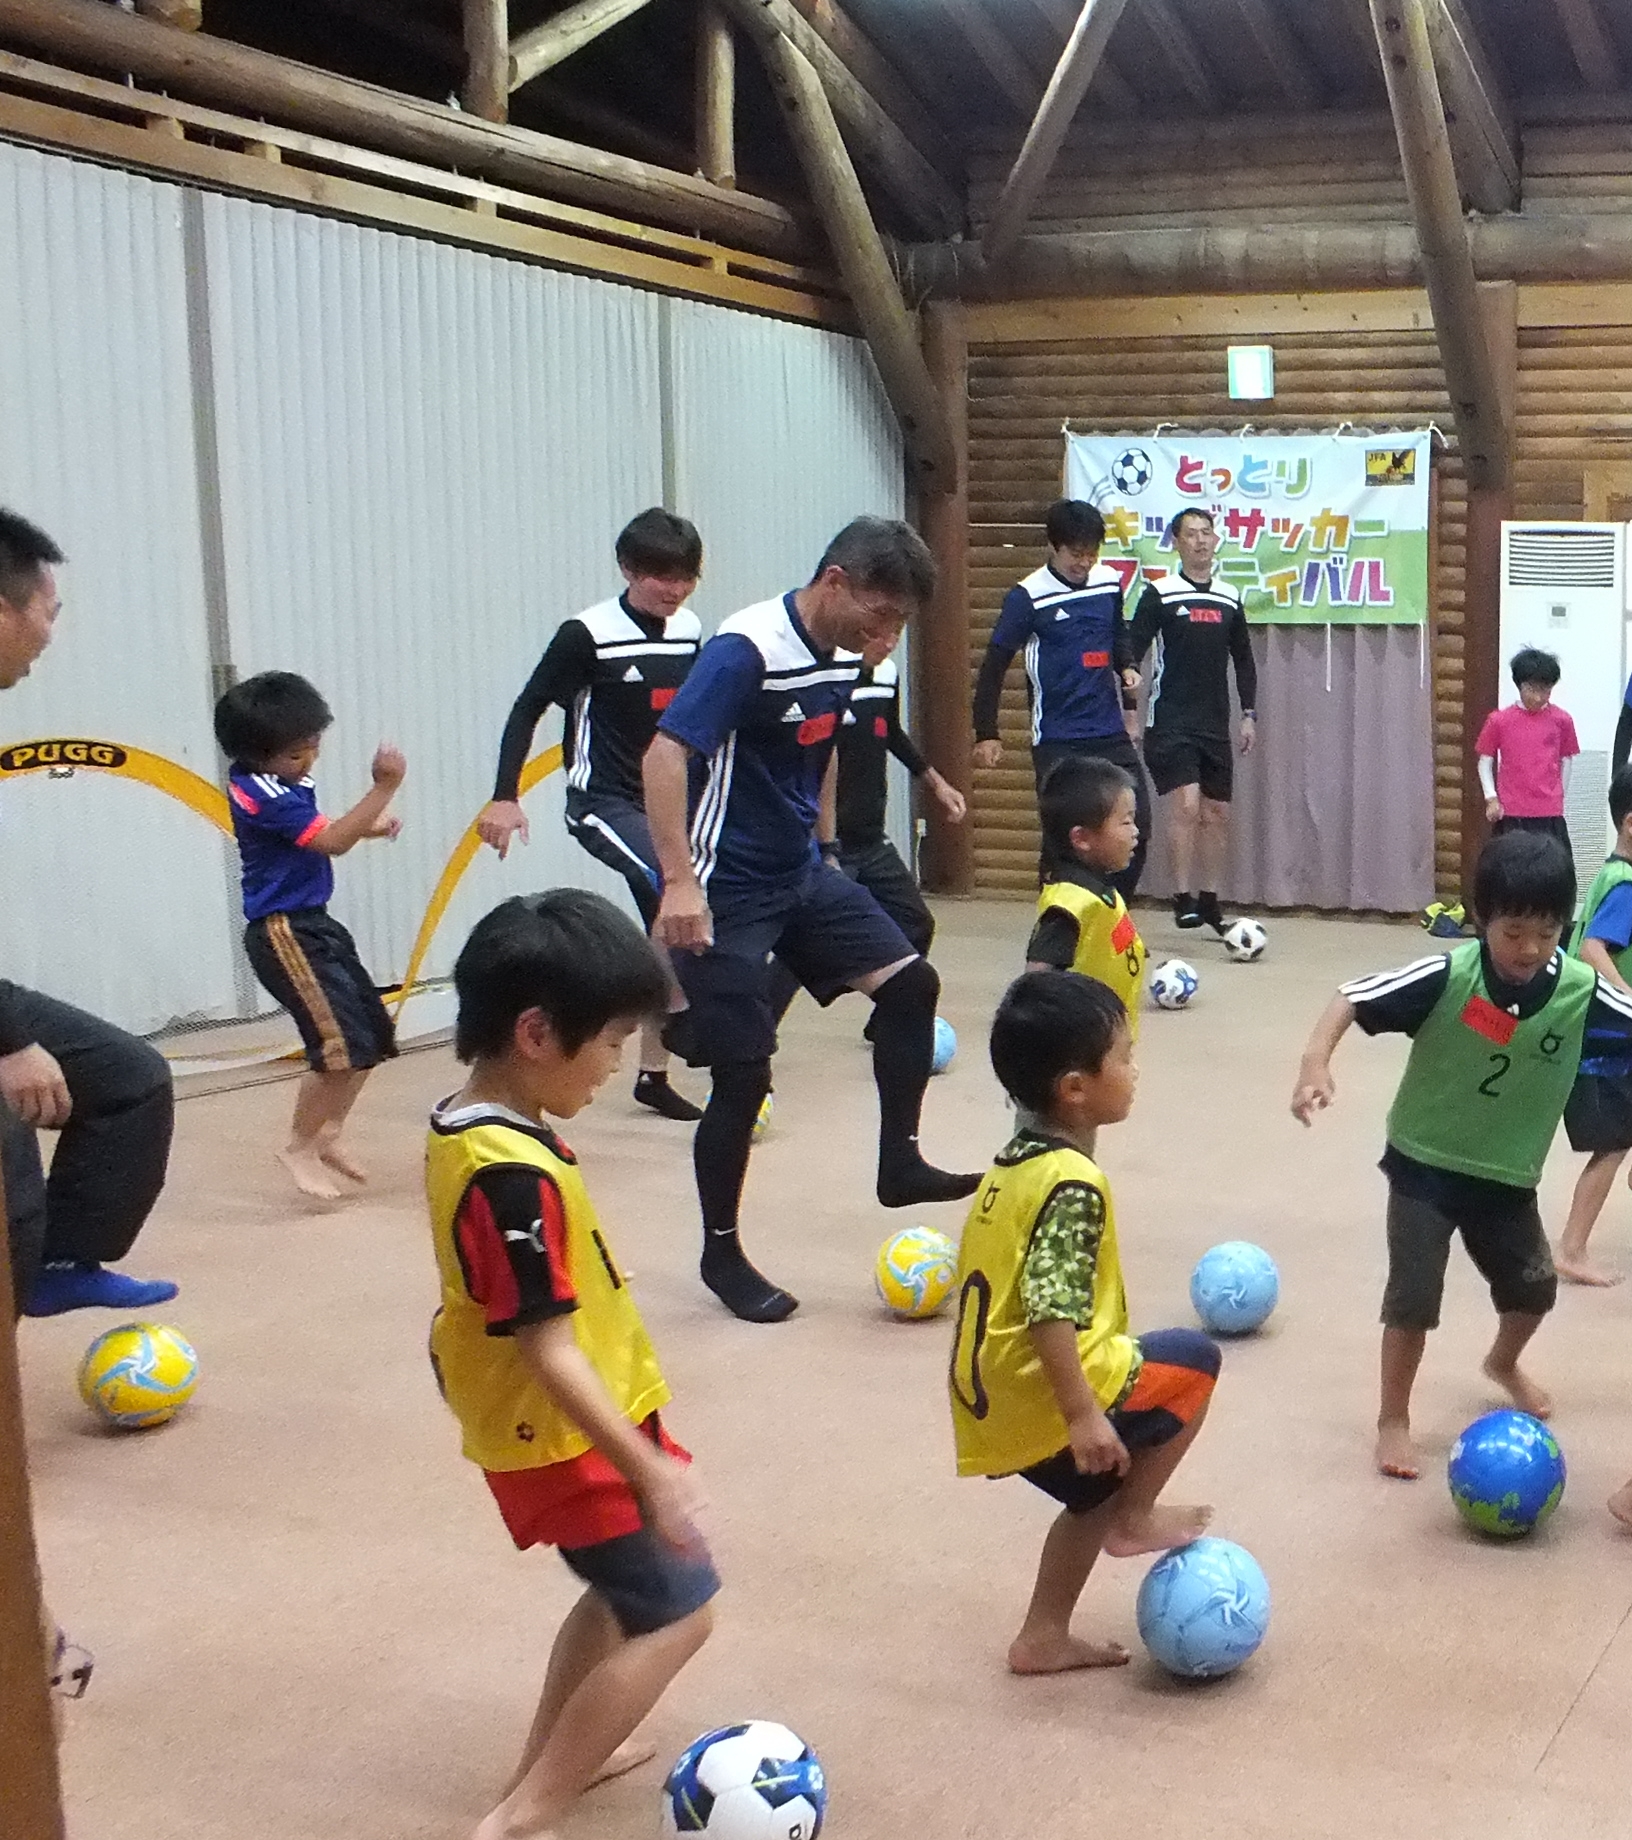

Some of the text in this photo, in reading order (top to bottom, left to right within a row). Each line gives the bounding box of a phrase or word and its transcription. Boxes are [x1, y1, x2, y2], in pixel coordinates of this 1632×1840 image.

[1174, 453, 1310, 497] とっとり
[1103, 504, 1389, 551] キッサッカー
[1101, 555, 1394, 606] フティバル
[11, 743, 114, 767] PUGG
[1477, 1052, 1511, 1098] 2
